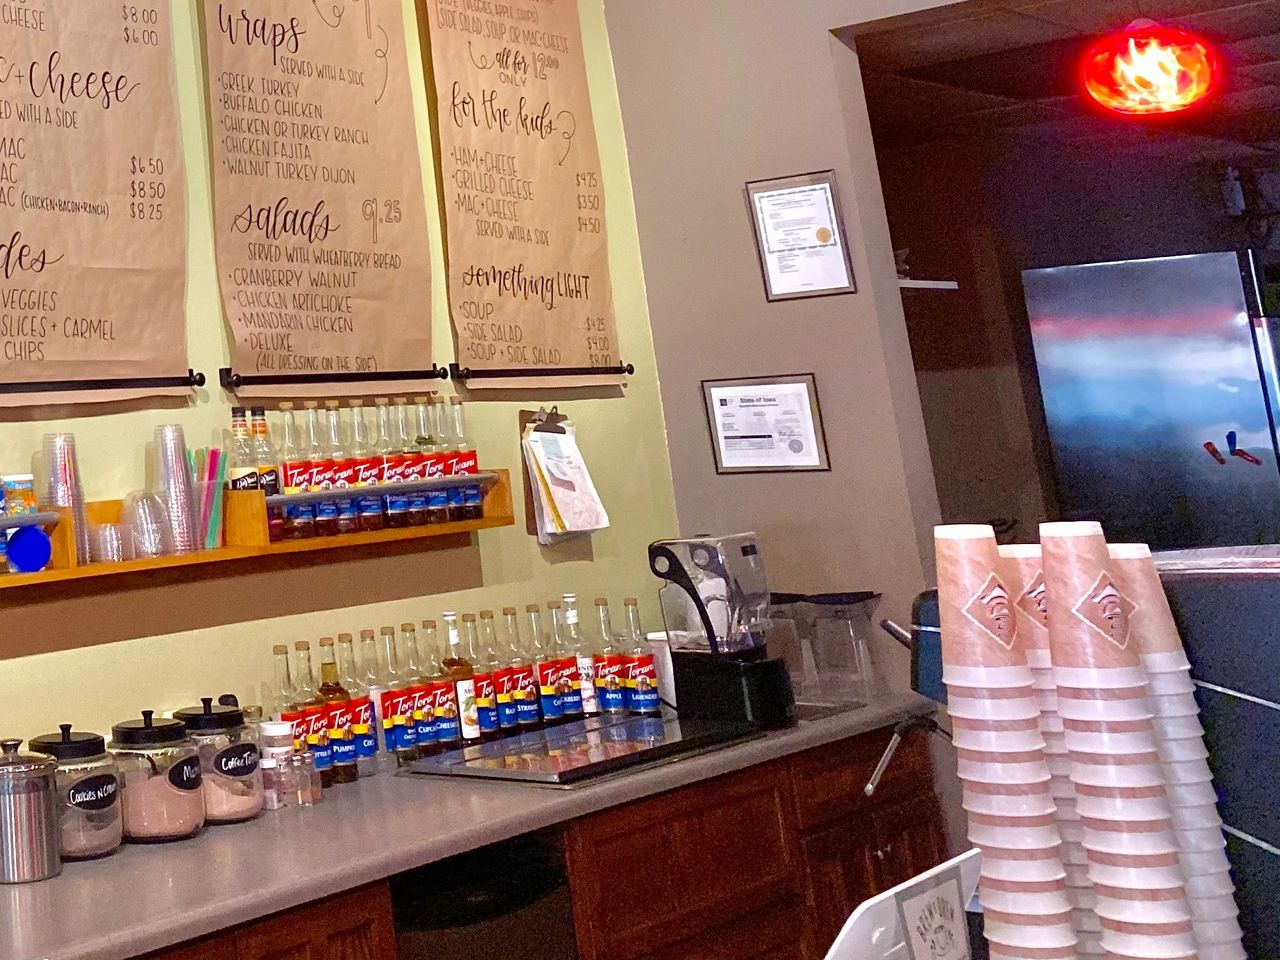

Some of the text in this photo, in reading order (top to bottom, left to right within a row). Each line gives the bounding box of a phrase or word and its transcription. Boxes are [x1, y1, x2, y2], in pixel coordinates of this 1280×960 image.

[3, 1, 45, 32] CHEESE
[222, 72, 300, 98] GREEK TURKEY
[226, 137, 270, 156] CHICKEN
[230, 197, 340, 244] salads
[234, 270, 358, 288] CRANBERRY WALNUT
[557, 272, 589, 300] LIGHT
[2, 289, 57, 311] VEGGIES
[463, 302, 493, 320] SOUP
[5, 340, 45, 361] CHIPS
